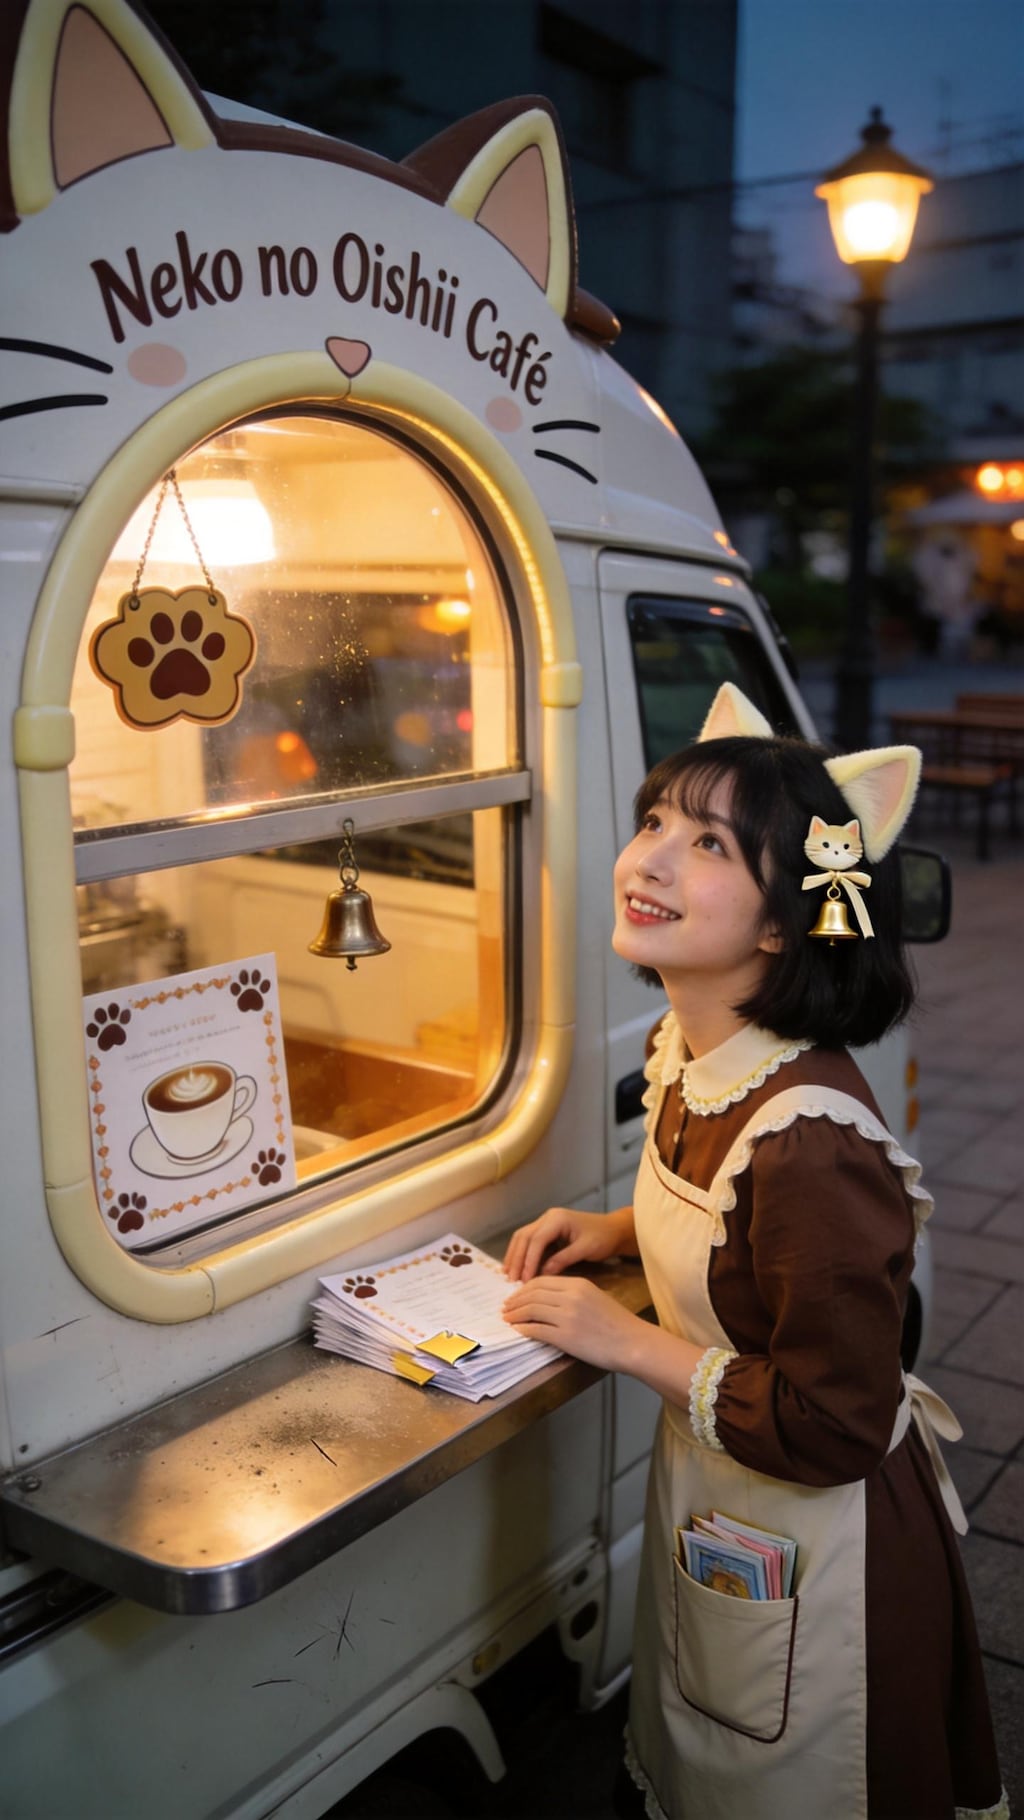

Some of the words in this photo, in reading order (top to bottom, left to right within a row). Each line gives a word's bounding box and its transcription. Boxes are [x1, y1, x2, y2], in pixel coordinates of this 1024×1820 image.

[90, 230, 243, 344] Neko
[258, 245, 318, 297] no
[333, 232, 460, 339] Oishii
[466, 298, 553, 406] Café
